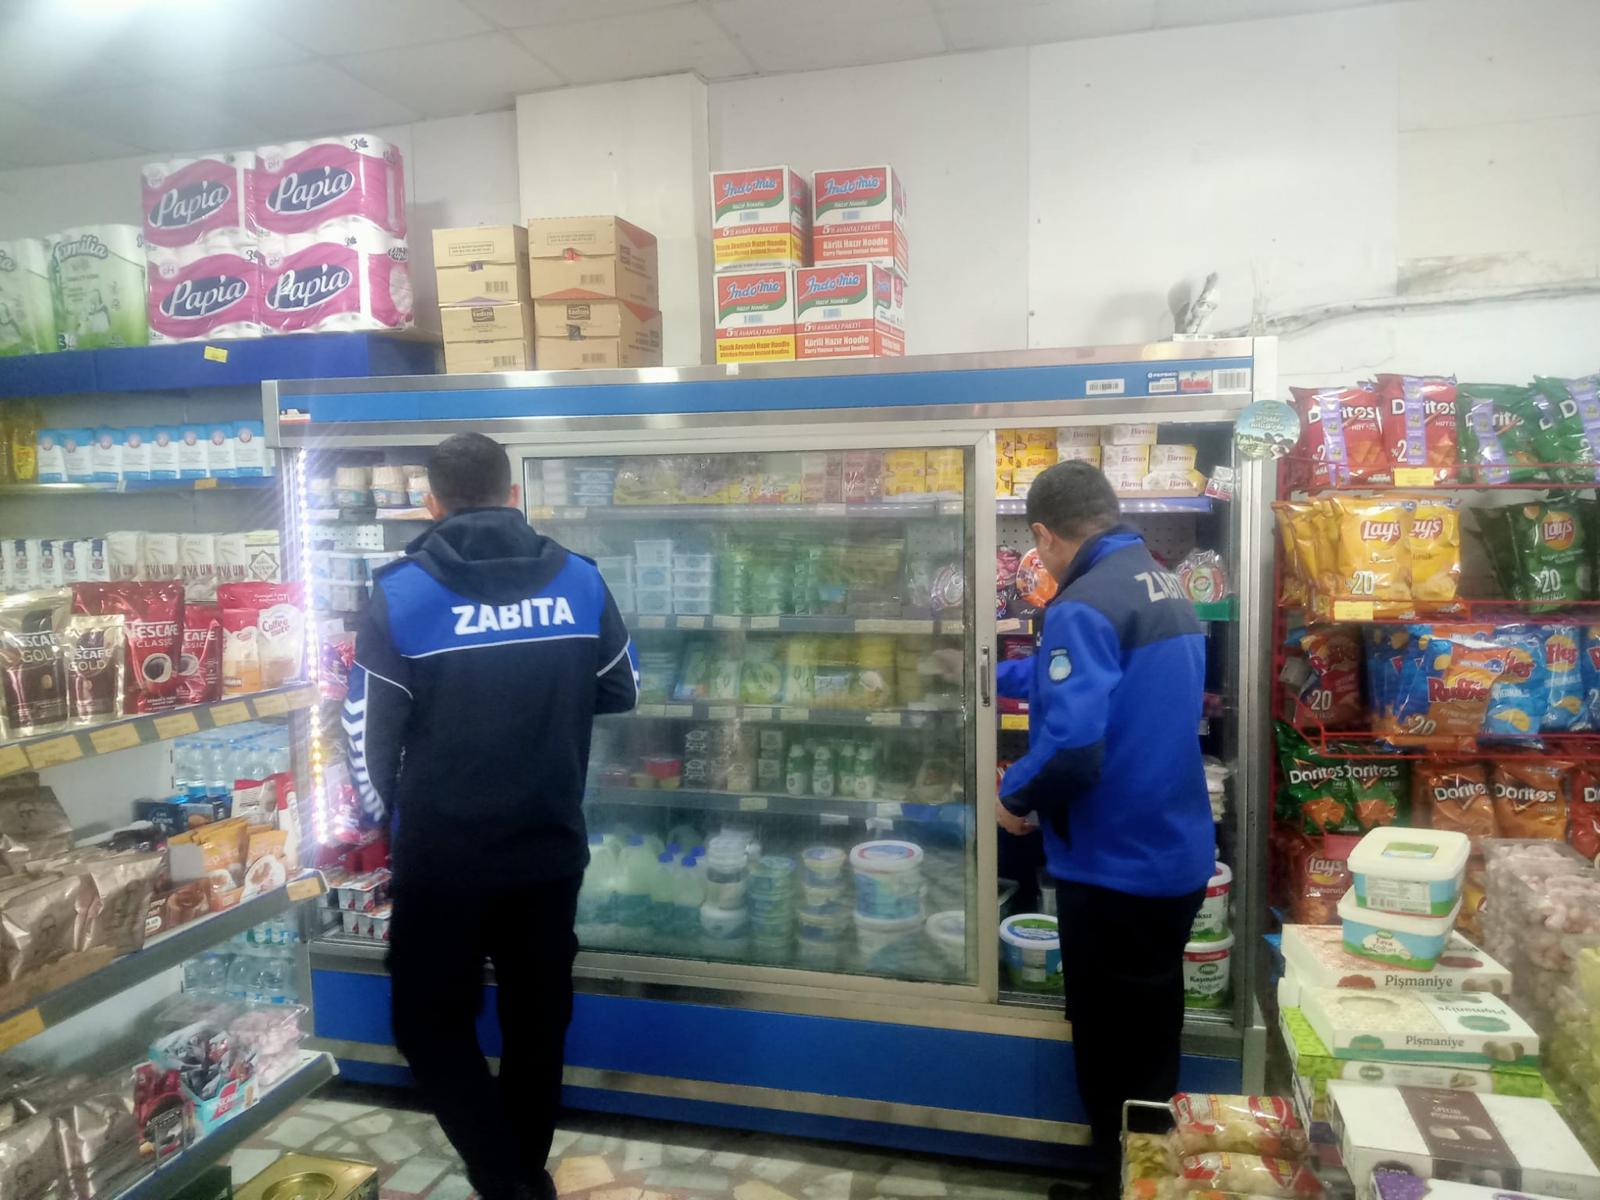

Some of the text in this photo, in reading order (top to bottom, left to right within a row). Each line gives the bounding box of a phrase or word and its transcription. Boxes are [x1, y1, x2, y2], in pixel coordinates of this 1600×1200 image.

[157, 181, 224, 227] Papia
[275, 166, 348, 212] Papia
[169, 275, 243, 316] Papia
[274, 264, 346, 309] Papia
[452, 597, 576, 635] ZABITA
[1289, 765, 1343, 784] Doritos
[1385, 975, 1453, 990] Pişmaniye
[1406, 1035, 1465, 1048] Pişmaniye
